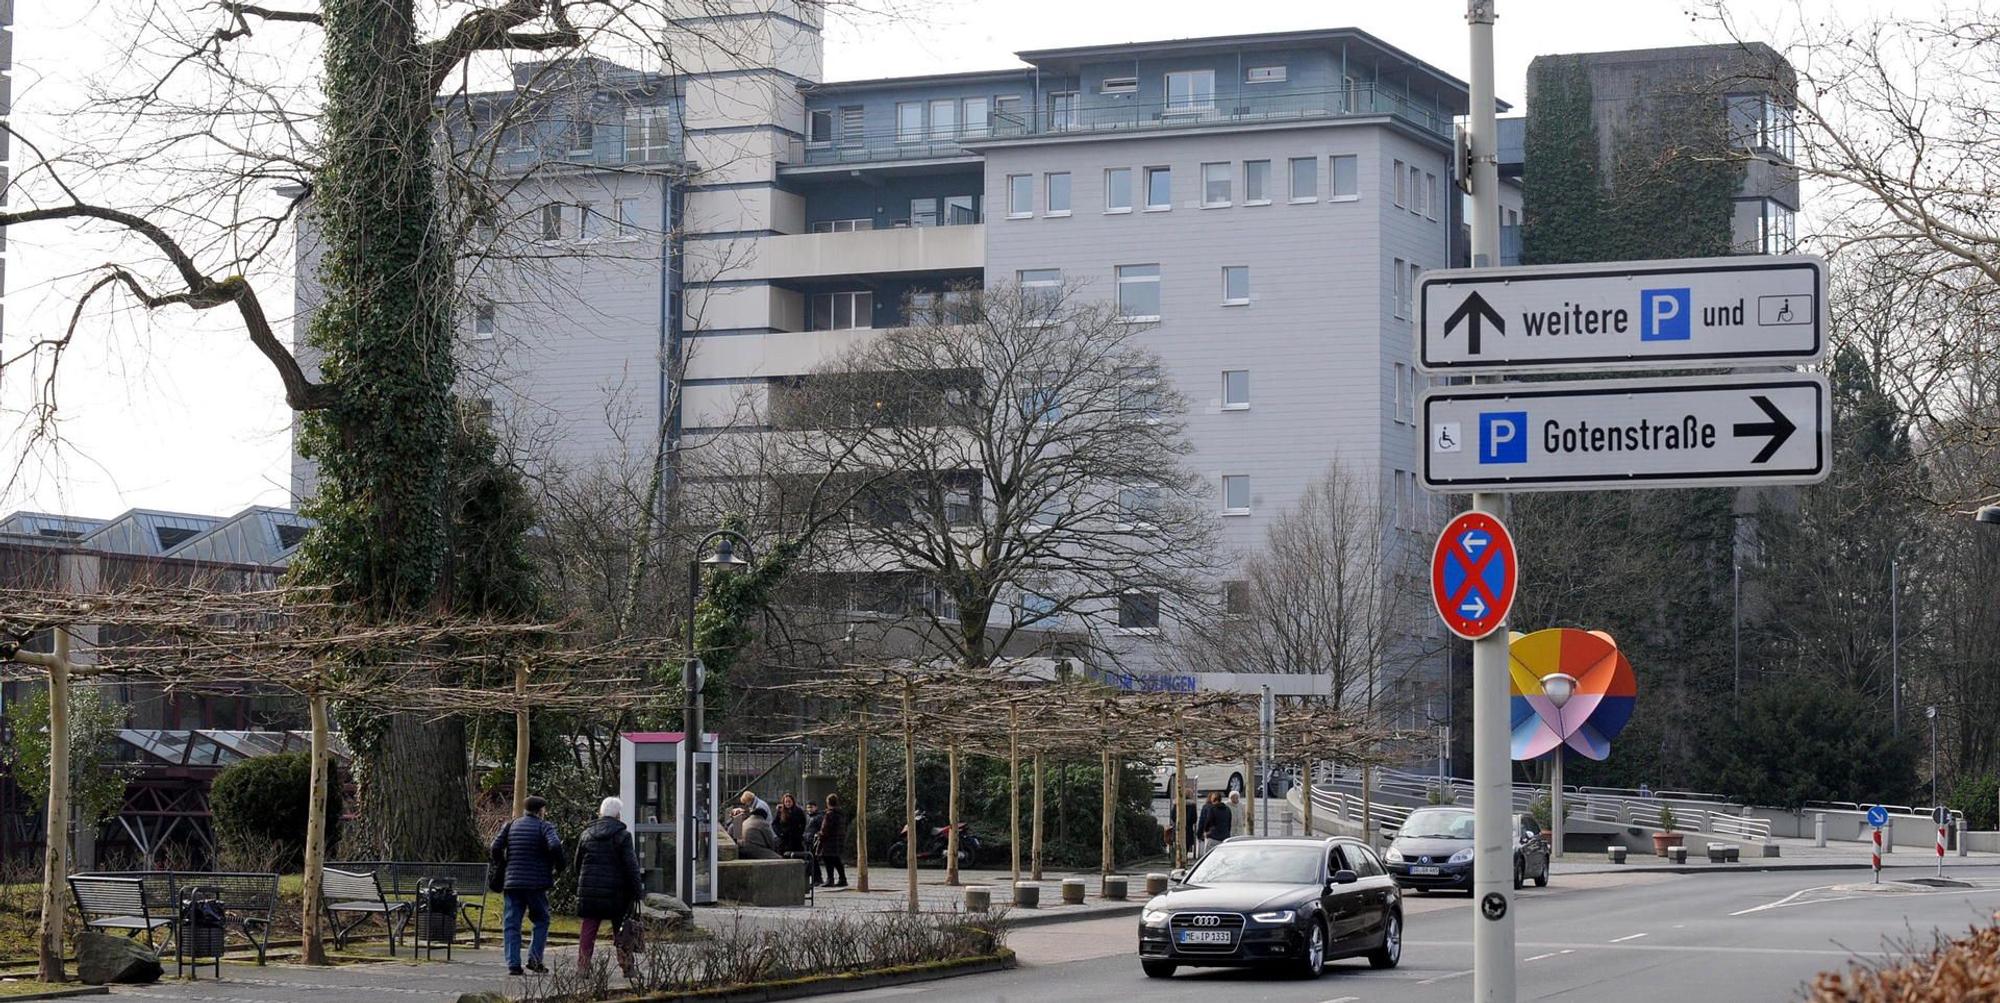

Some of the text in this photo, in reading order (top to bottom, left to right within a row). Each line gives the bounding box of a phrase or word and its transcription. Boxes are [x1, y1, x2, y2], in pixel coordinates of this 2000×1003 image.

[1523, 295, 1744, 337] weitere P und
[1490, 414, 1716, 457] P Gotenstraße
